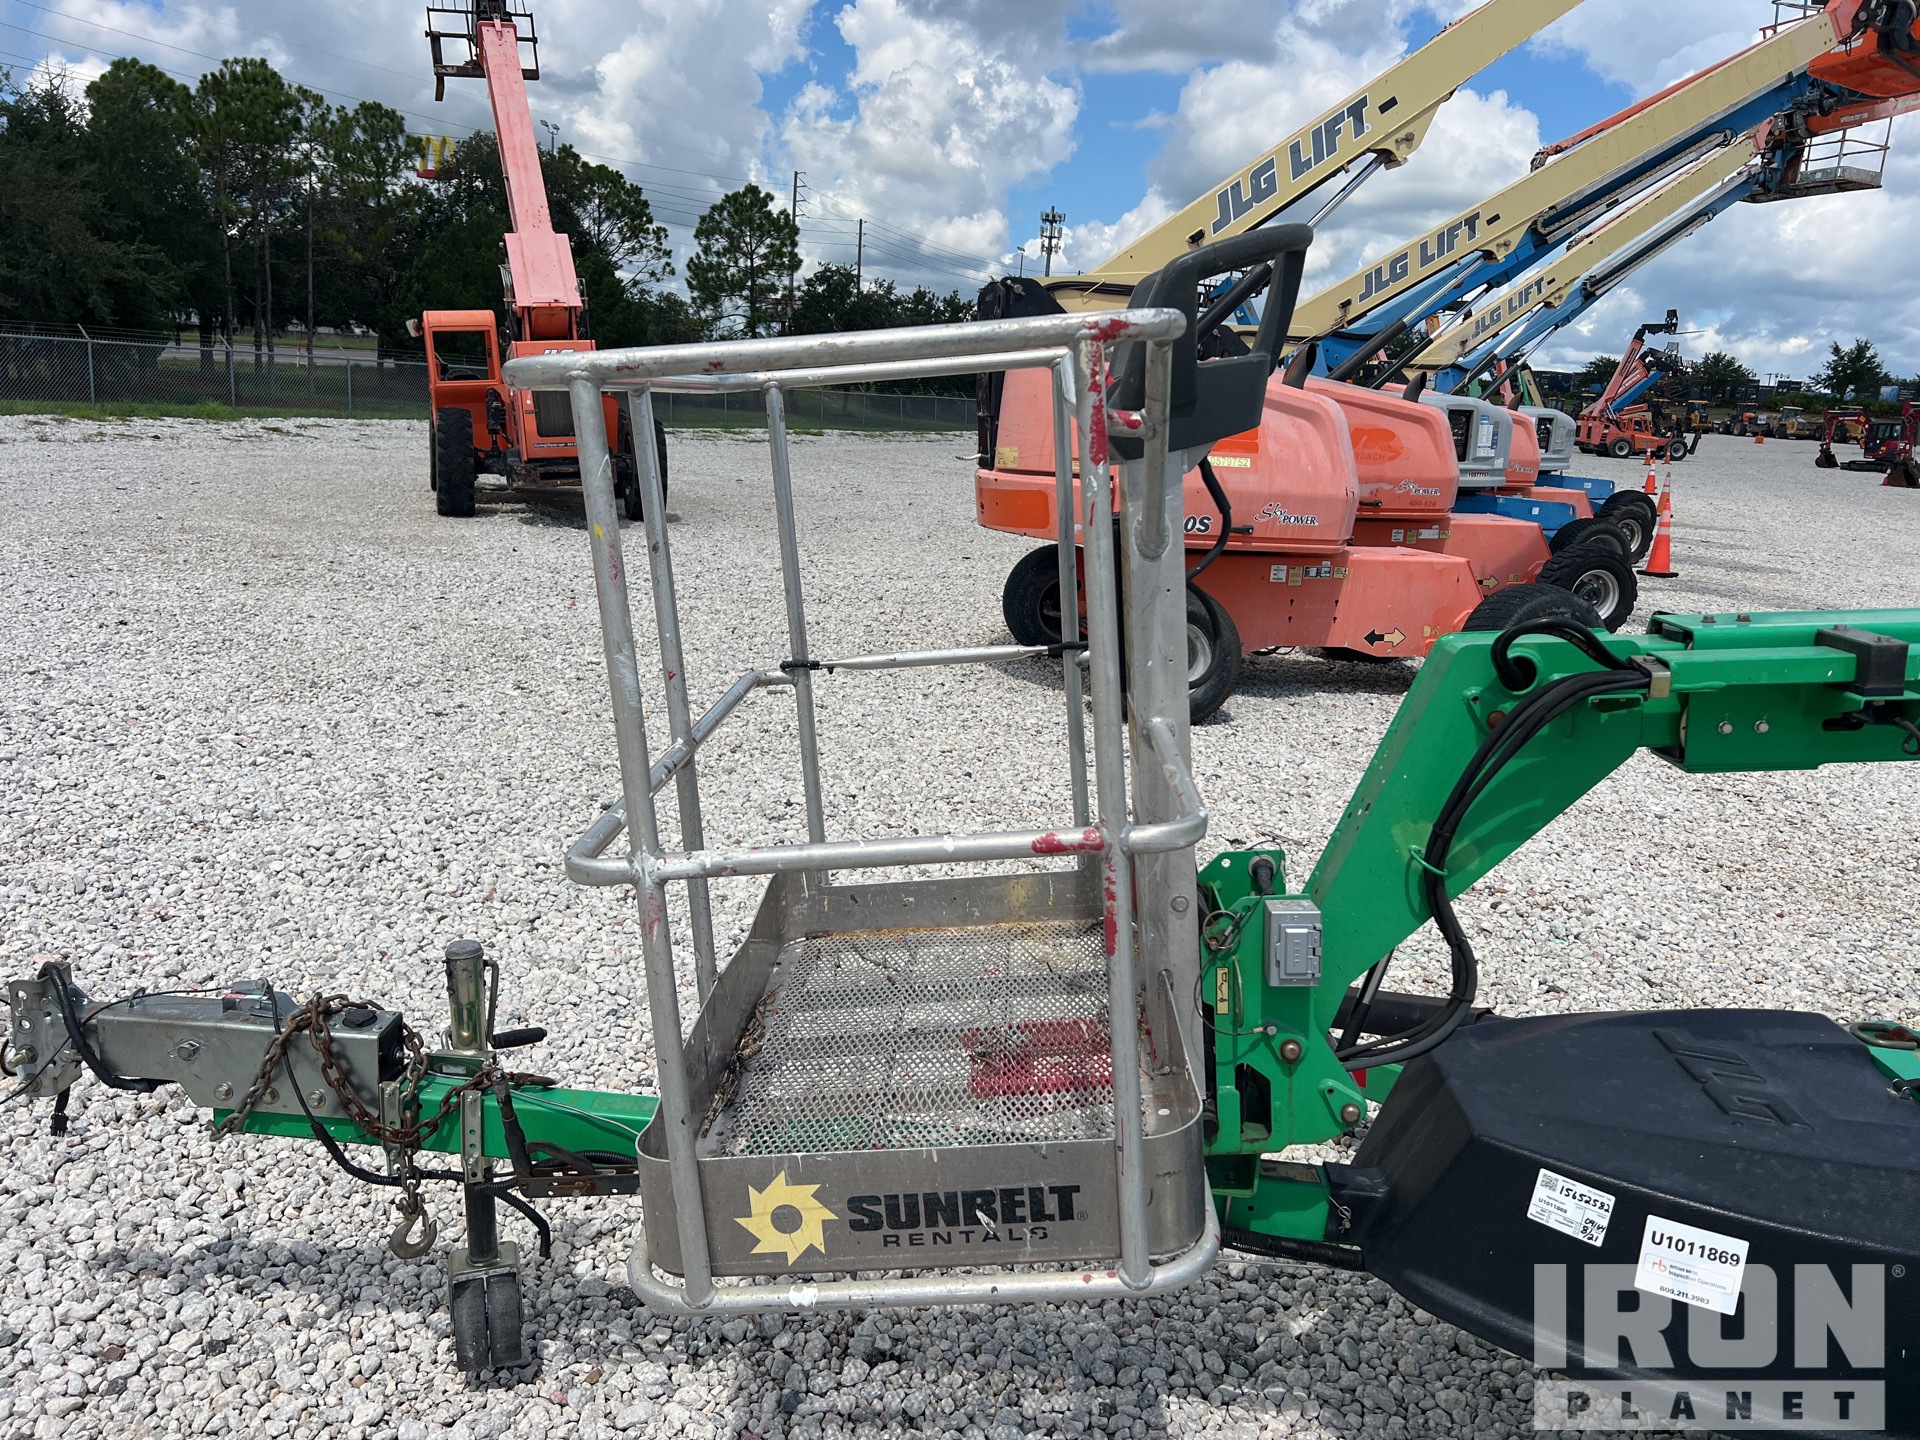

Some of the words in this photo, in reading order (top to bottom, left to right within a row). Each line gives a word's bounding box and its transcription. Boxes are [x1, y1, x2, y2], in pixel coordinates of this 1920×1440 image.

[1211, 155, 1278, 237] JLG
[1288, 93, 1369, 183] LIFT
[1358, 250, 1409, 304] JLG
[1419, 210, 1481, 270] LIFT
[1472, 304, 1502, 339] JLG
[1507, 275, 1545, 316] LIFT
[1254, 502, 1287, 525] Sky
[1282, 515, 1317, 525] POWER
[846, 1185, 1081, 1232] SUNBELT
[1538, 1197, 1568, 1214] U1011869
[1560, 1185, 1611, 1213] 15652582
[883, 1226, 1049, 1248] RENTALS
[1581, 1225, 1599, 1242] 8/21
[1651, 1230, 1741, 1267] U1011869
[1668, 1270, 1697, 1283] Inspection
[1697, 1278, 1727, 1291] Operations
[1659, 1285, 1710, 1305] 800.211.3983
